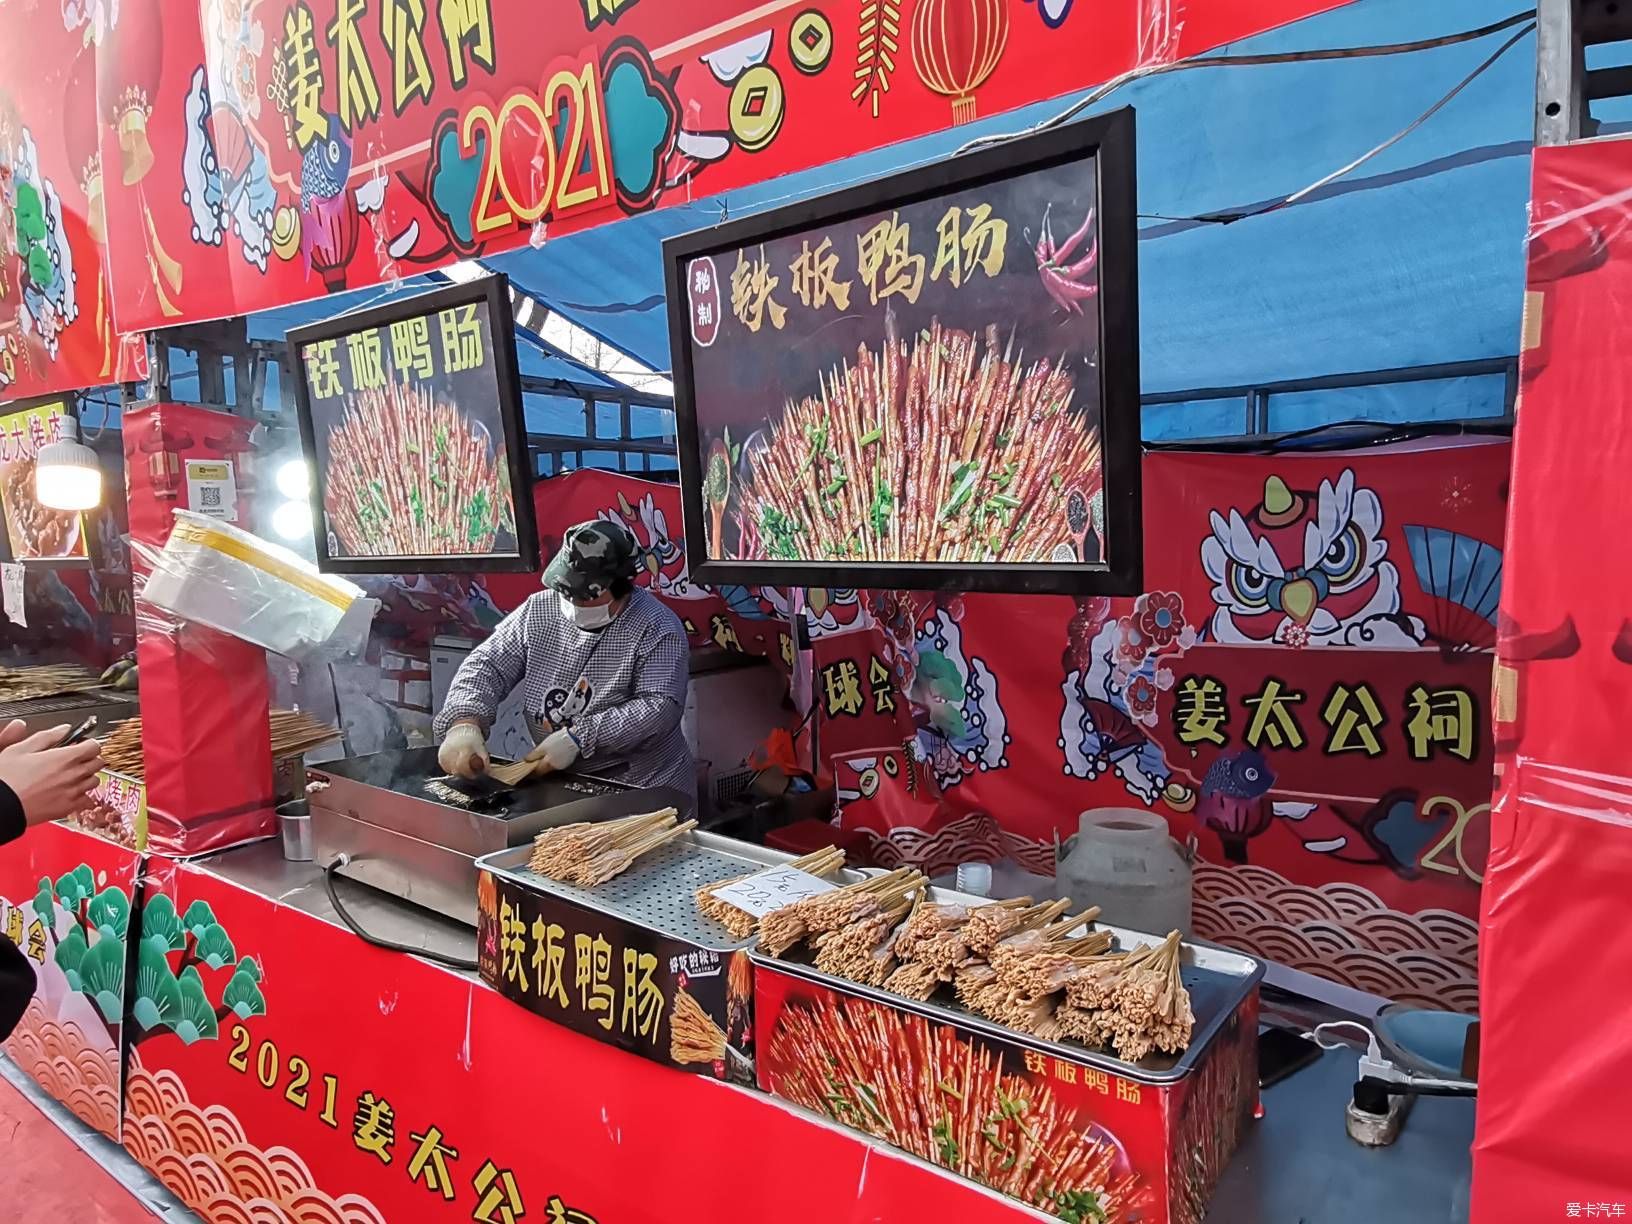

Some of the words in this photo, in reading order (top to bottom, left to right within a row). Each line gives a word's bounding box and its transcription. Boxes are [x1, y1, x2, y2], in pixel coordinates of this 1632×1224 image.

[285, 0, 493, 149] 姜太公祠
[463, 62, 610, 233] 2021
[730, 203, 1008, 333] 铁板鸭肠
[302, 303, 484, 400] 铁板鸭肠
[822, 655, 896, 716] 球会
[1177, 677, 1474, 760] 姜太公祠
[500, 893, 665, 1046] 铁板鸭肠
[1024, 1049, 1141, 1105] 铁板鸭肠
